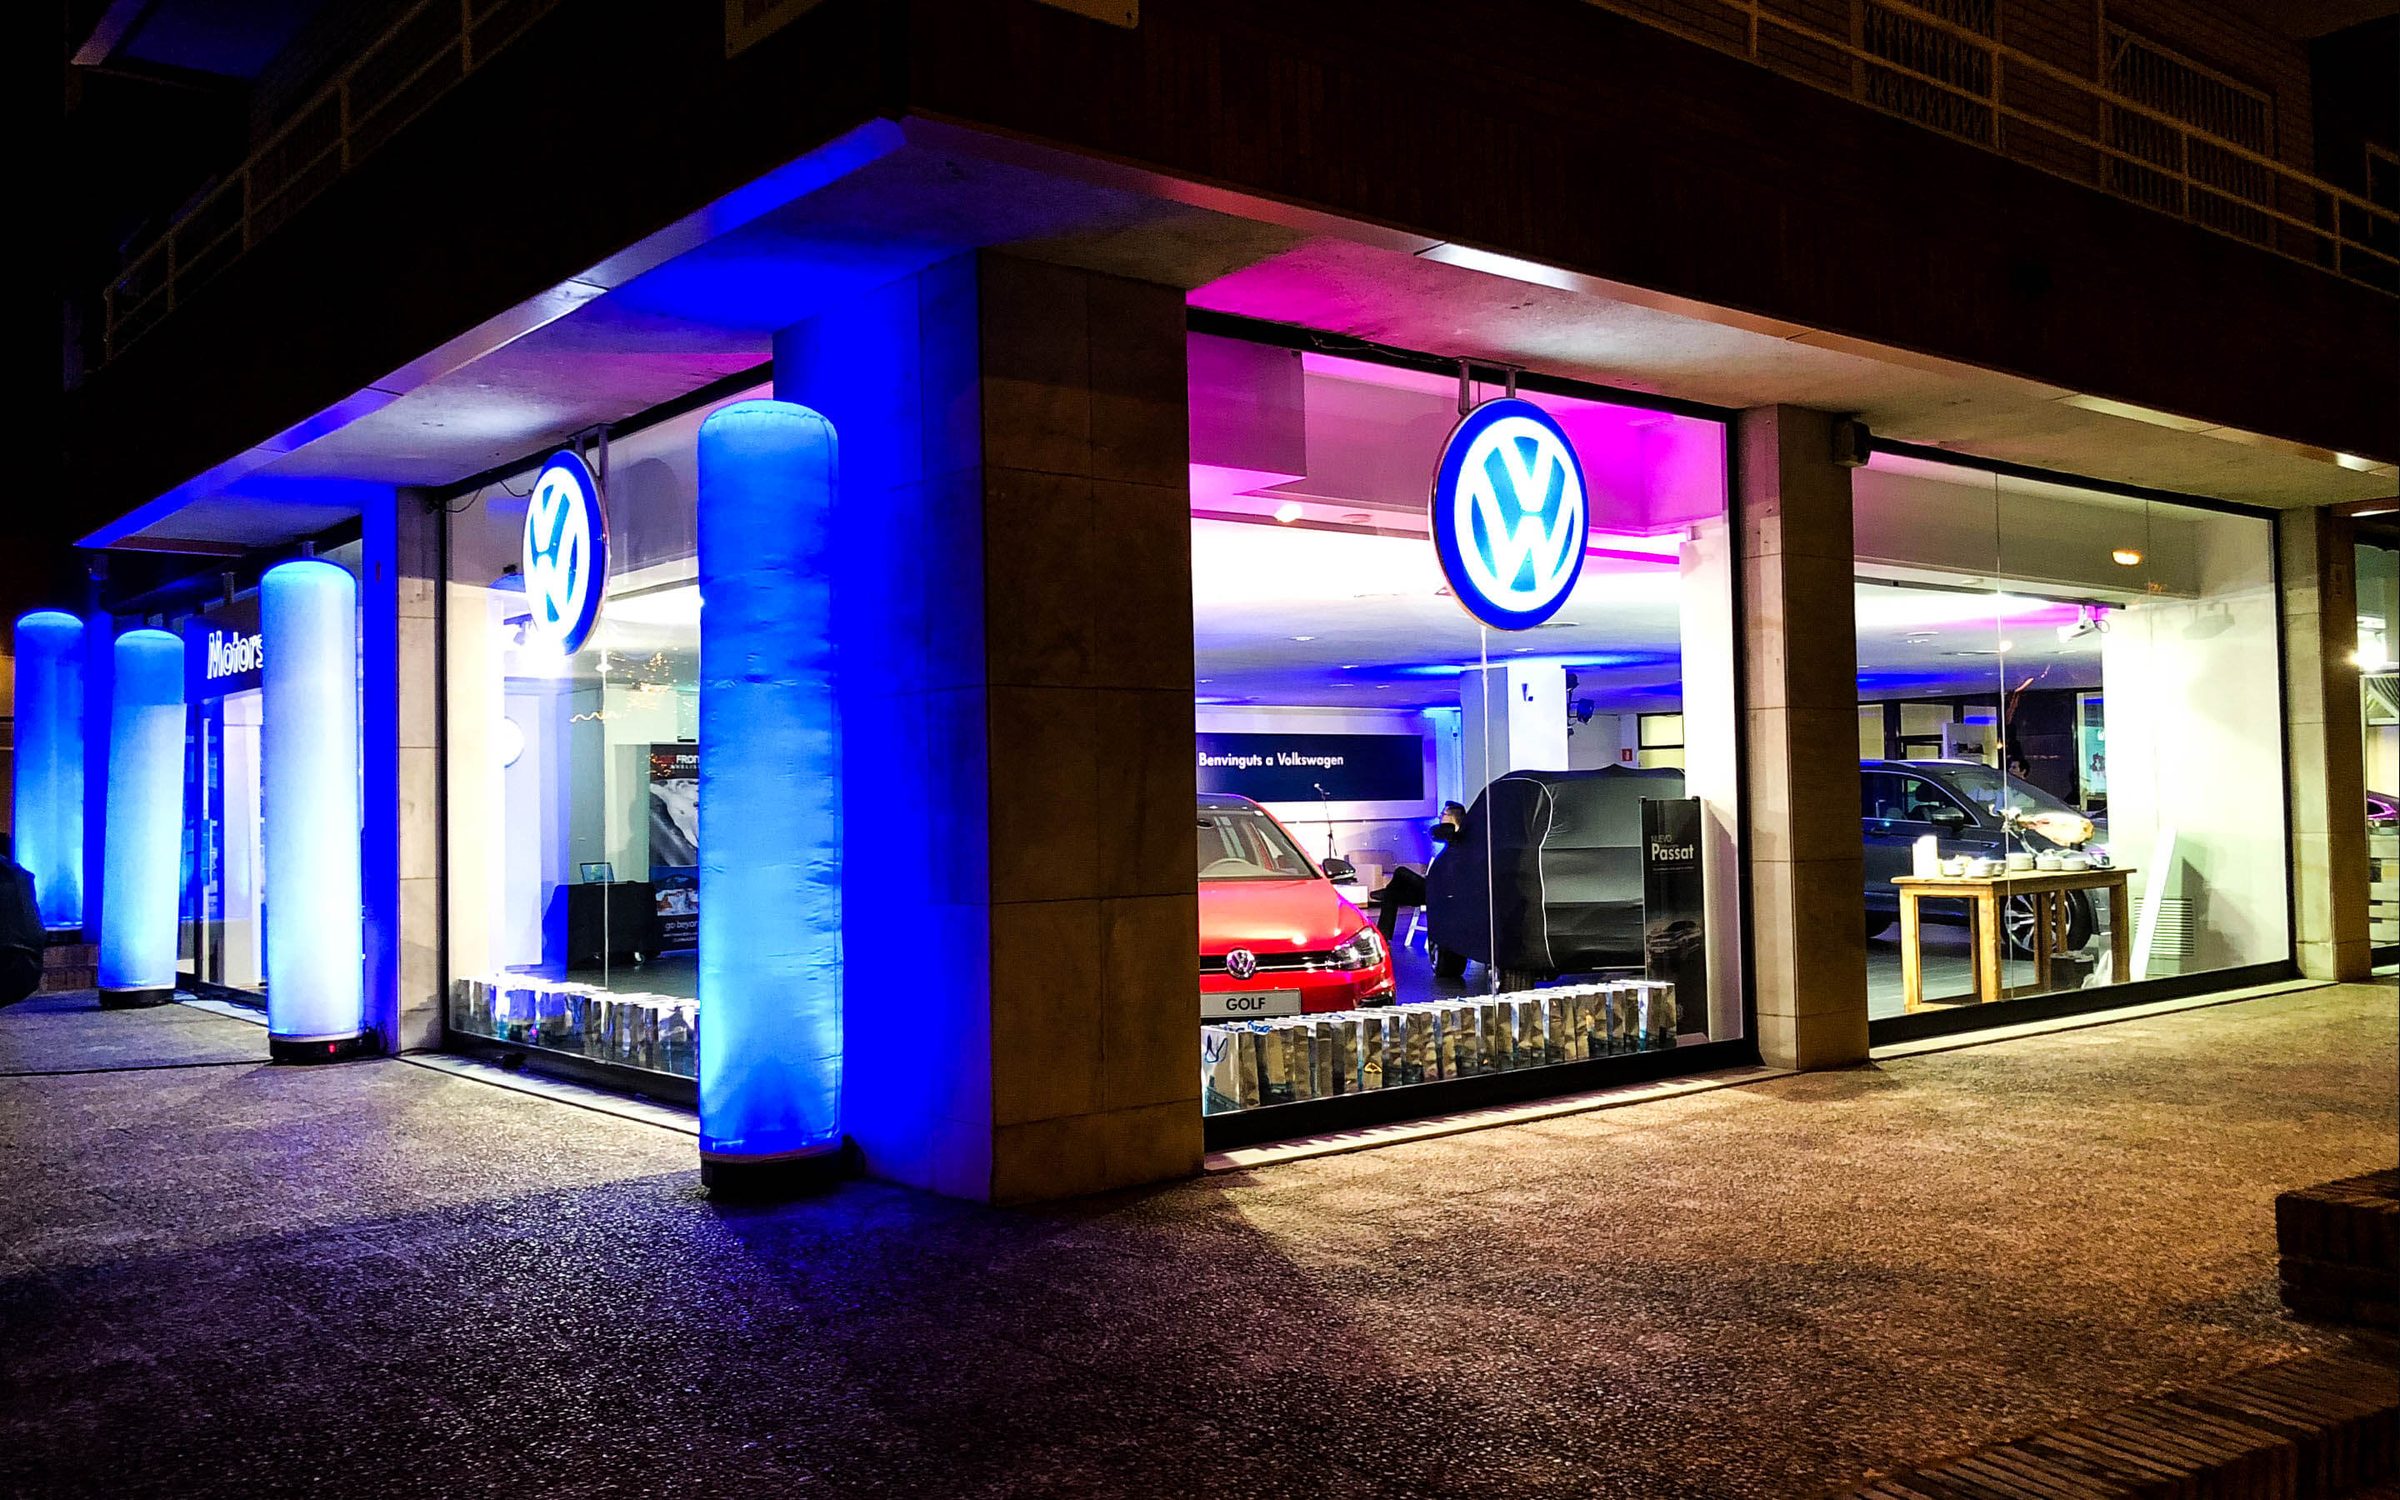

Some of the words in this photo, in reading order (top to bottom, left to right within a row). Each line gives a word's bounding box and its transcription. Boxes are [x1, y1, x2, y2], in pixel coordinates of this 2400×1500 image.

[1198, 752, 1263, 769] Benvinguts
[1265, 756, 1274, 766] a
[1277, 752, 1344, 768] Volkswagen
[1651, 843, 1694, 861] Passat
[1225, 997, 1266, 1011] GOLF
